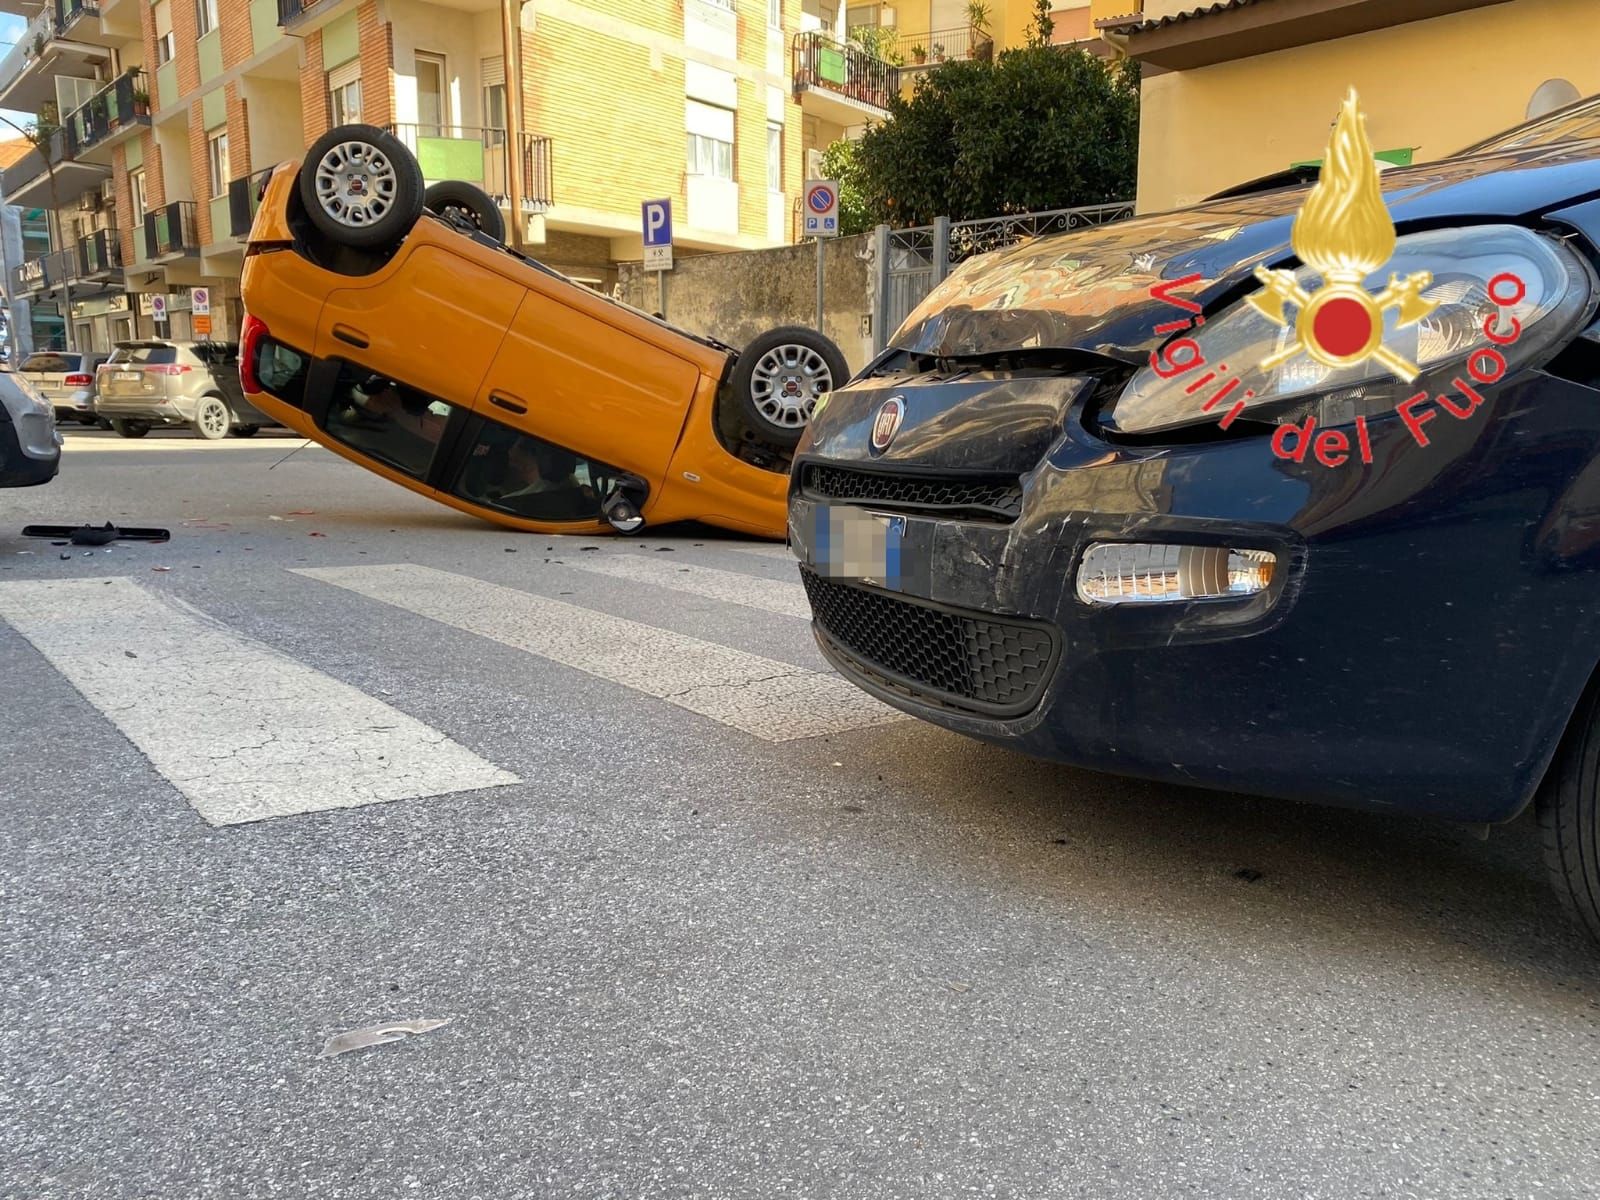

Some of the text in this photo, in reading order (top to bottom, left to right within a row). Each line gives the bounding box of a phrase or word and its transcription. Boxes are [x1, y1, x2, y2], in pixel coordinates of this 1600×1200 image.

[647, 204, 665, 242] P
[809, 218, 816, 229] P
[877, 413, 897, 437] FIAT
